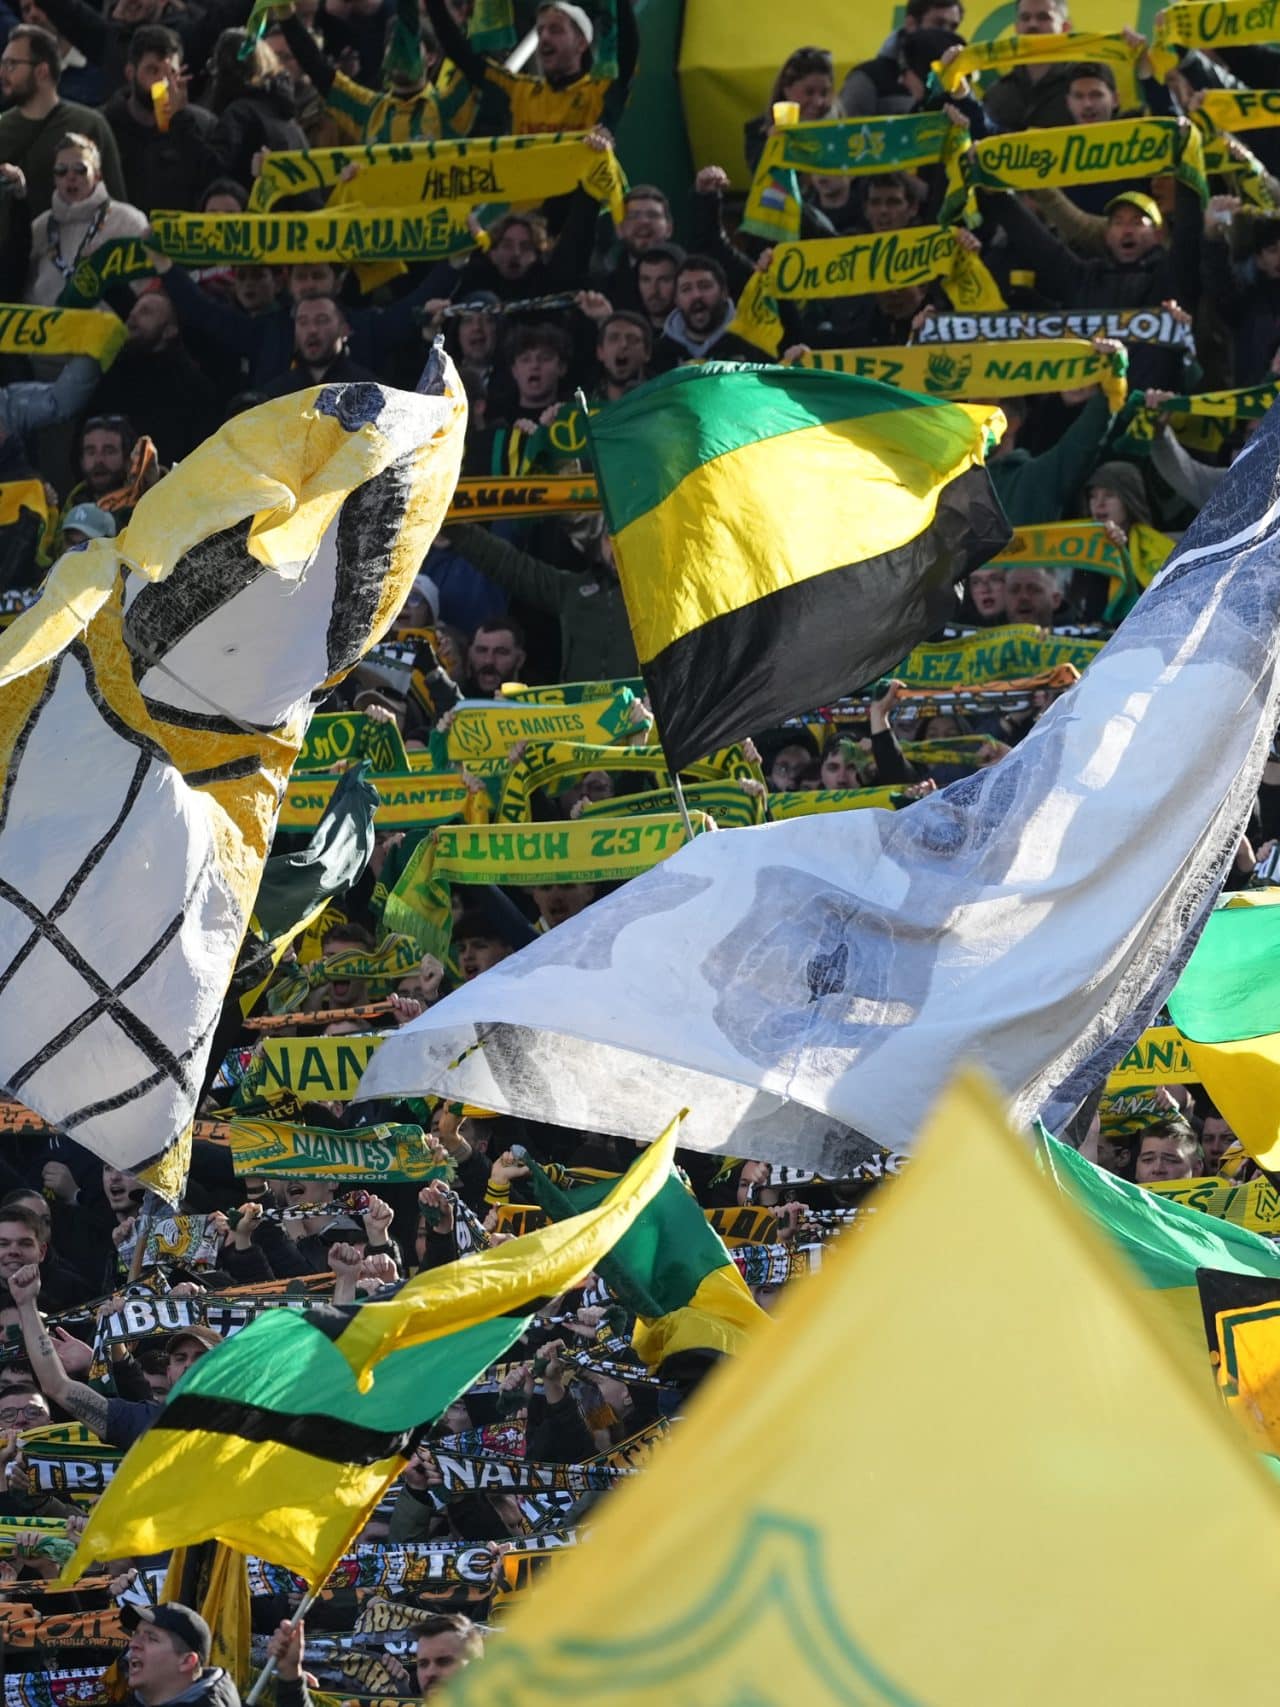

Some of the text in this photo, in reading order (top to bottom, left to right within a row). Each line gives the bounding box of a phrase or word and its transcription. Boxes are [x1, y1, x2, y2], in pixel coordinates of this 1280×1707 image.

[1199, 2, 1238, 41] On
[982, 128, 1168, 178] Allez Nantes
[221, 218, 309, 251] MUR
[777, 231, 957, 293] On est Nantes
[497, 714, 585, 738] FC NANTES
[290, 796, 325, 810] ON
[293, 1133, 394, 1172] NANTES
[435, 1455, 556, 1491] NAN
